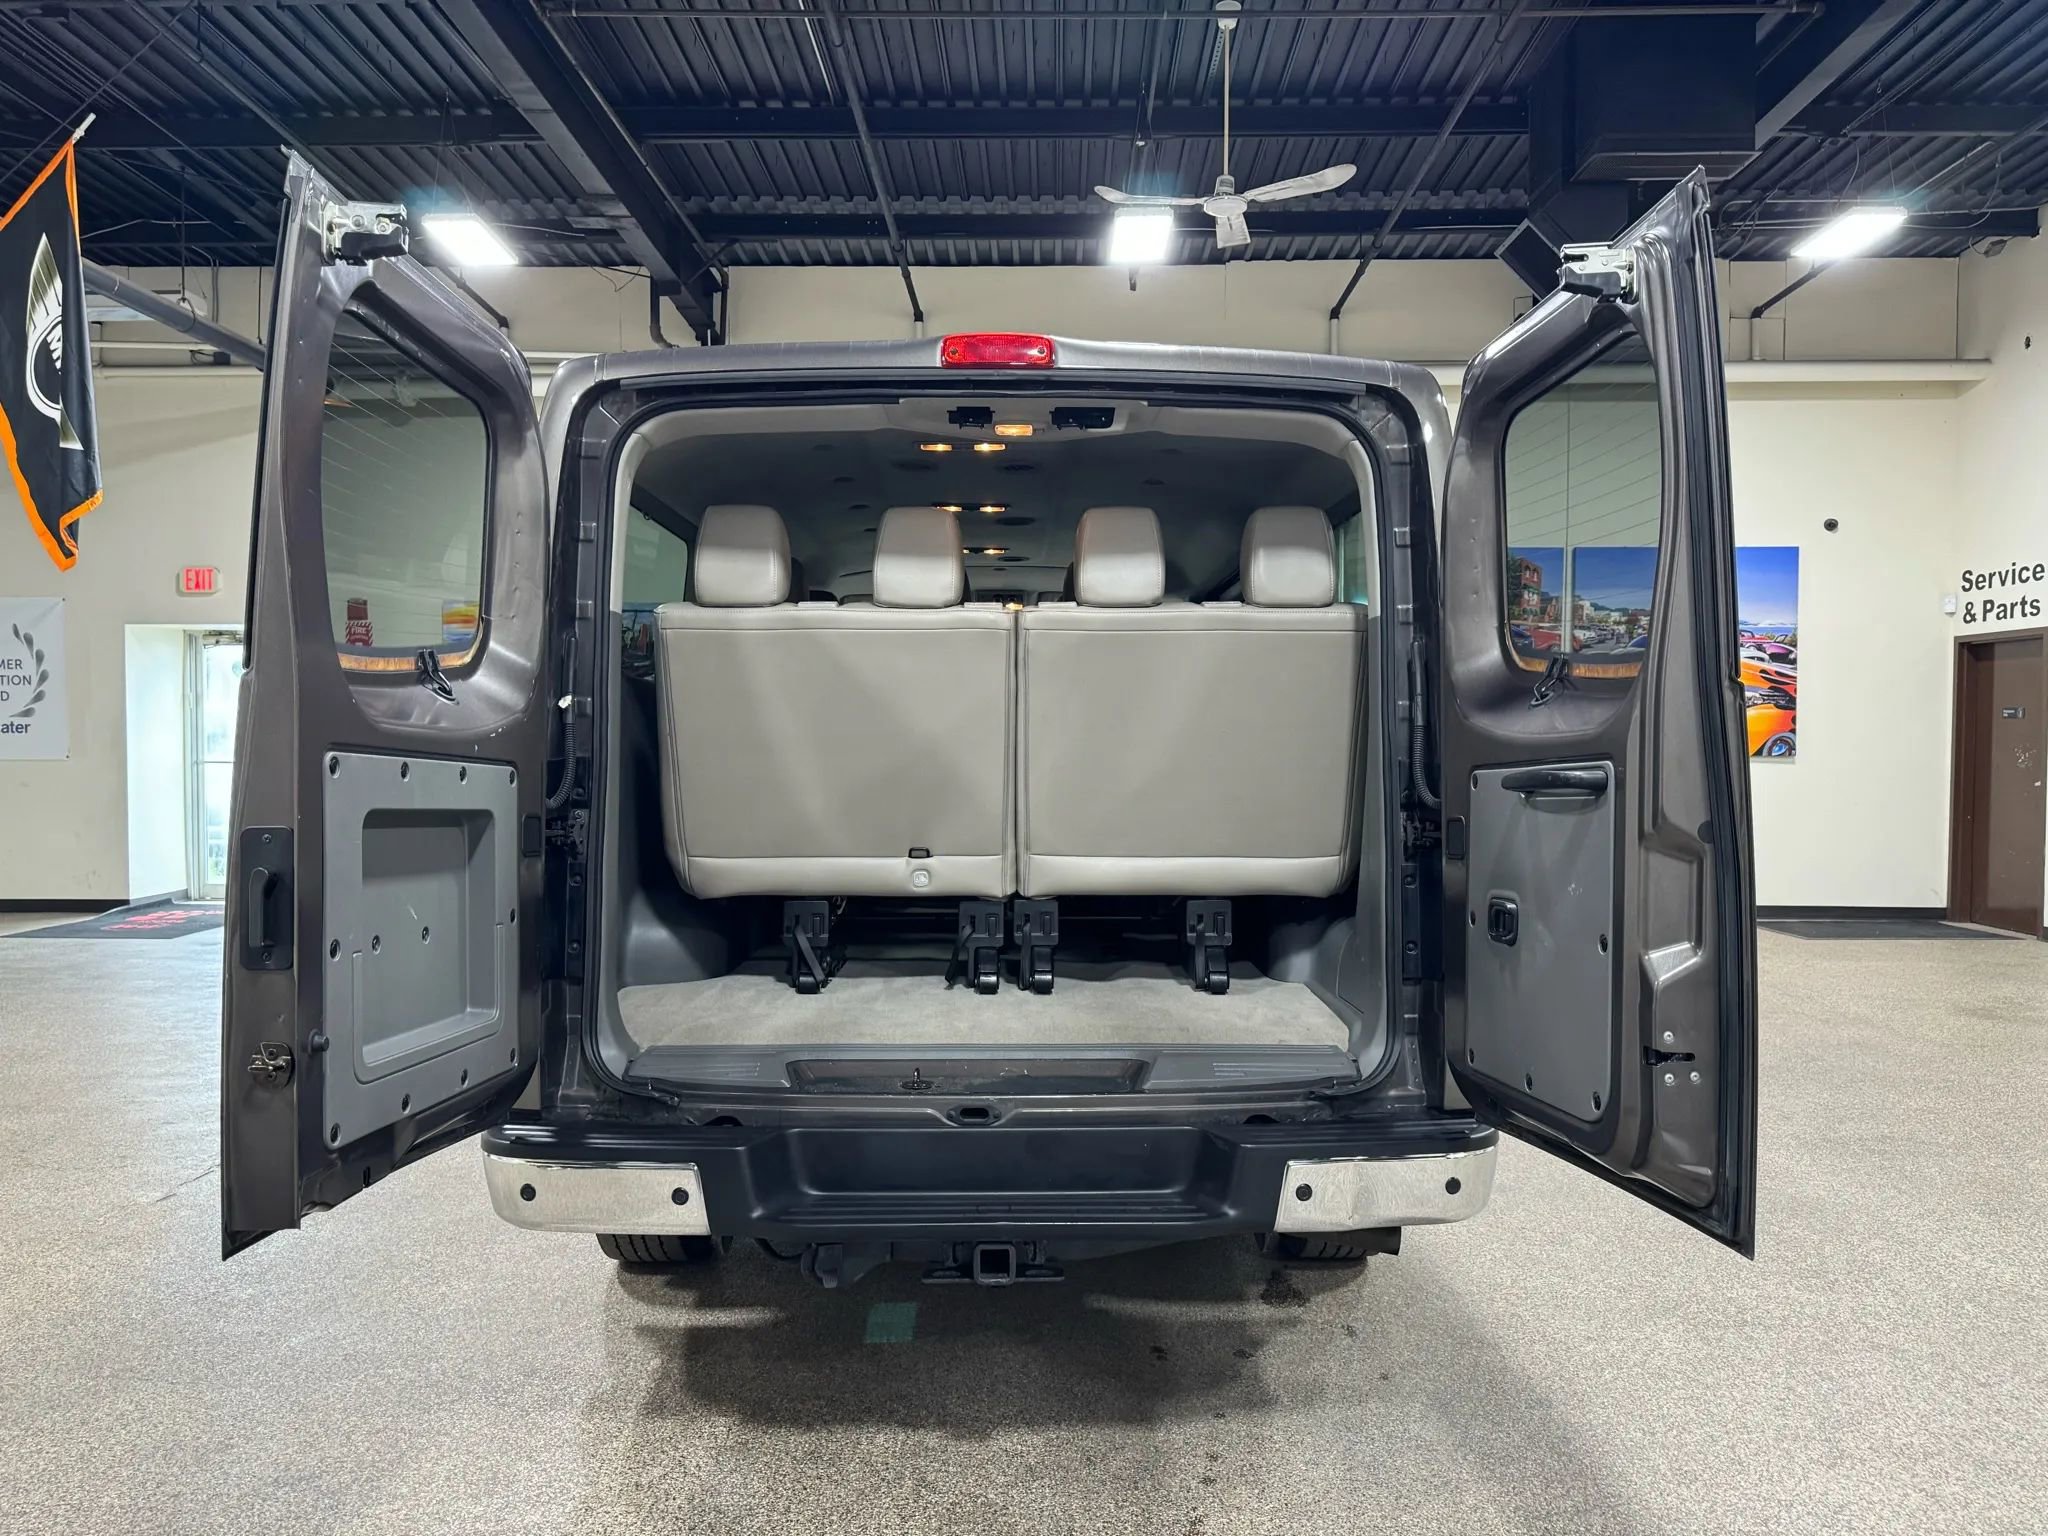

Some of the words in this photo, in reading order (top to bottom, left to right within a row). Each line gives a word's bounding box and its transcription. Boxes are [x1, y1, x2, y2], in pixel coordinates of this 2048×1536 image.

[186, 569, 213, 590] EXIT
[1961, 562, 2046, 592] Service
[1963, 601, 1977, 624] &
[1982, 595, 2041, 622] Parts
[351, 626, 367, 634] FIRE
